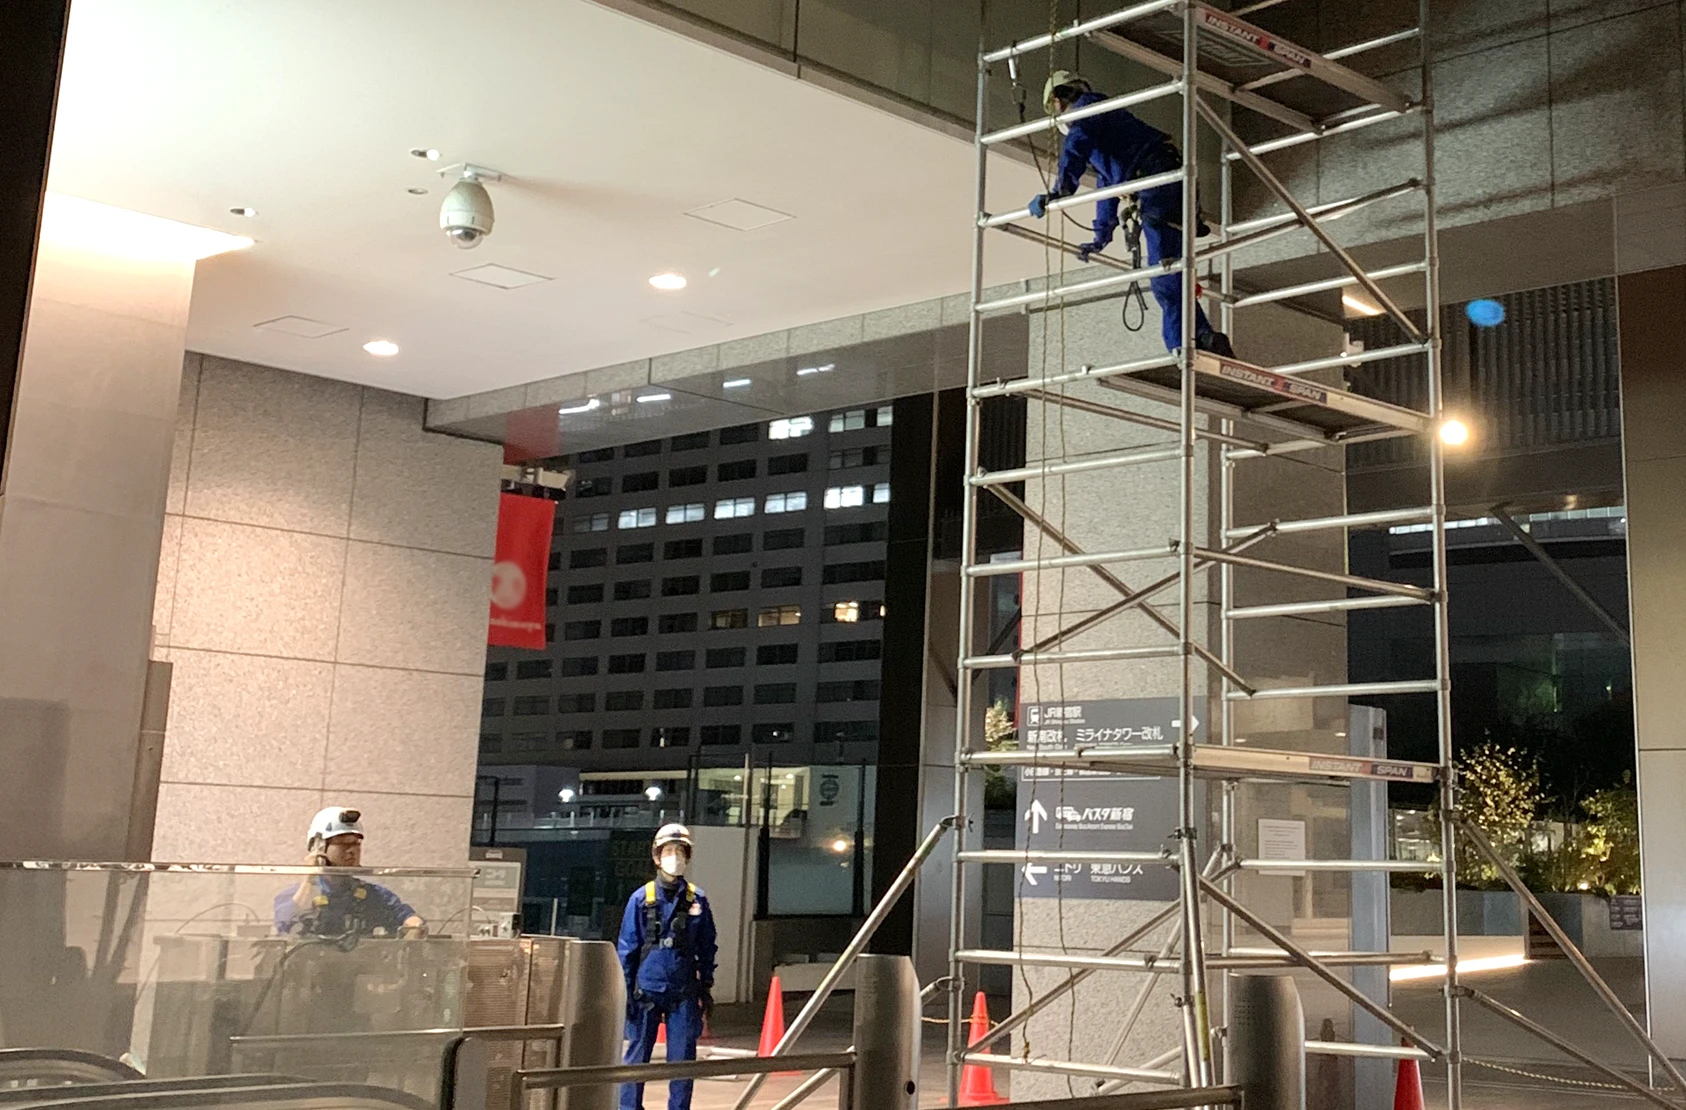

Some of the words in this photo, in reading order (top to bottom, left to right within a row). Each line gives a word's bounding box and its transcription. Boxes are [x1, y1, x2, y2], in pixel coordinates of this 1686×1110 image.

[1207, 15, 1260, 44] INSTANT
[1273, 43, 1305, 64] SPAN
[1221, 365, 1275, 387] INSTANT
[1288, 382, 1321, 399] SPAN
[1076, 726, 1163, 742] ミライナタワー改札
[1311, 760, 1361, 773] INSTANT
[1375, 765, 1408, 777] SPAN
[1081, 807, 1135, 821] バスタ新宿
